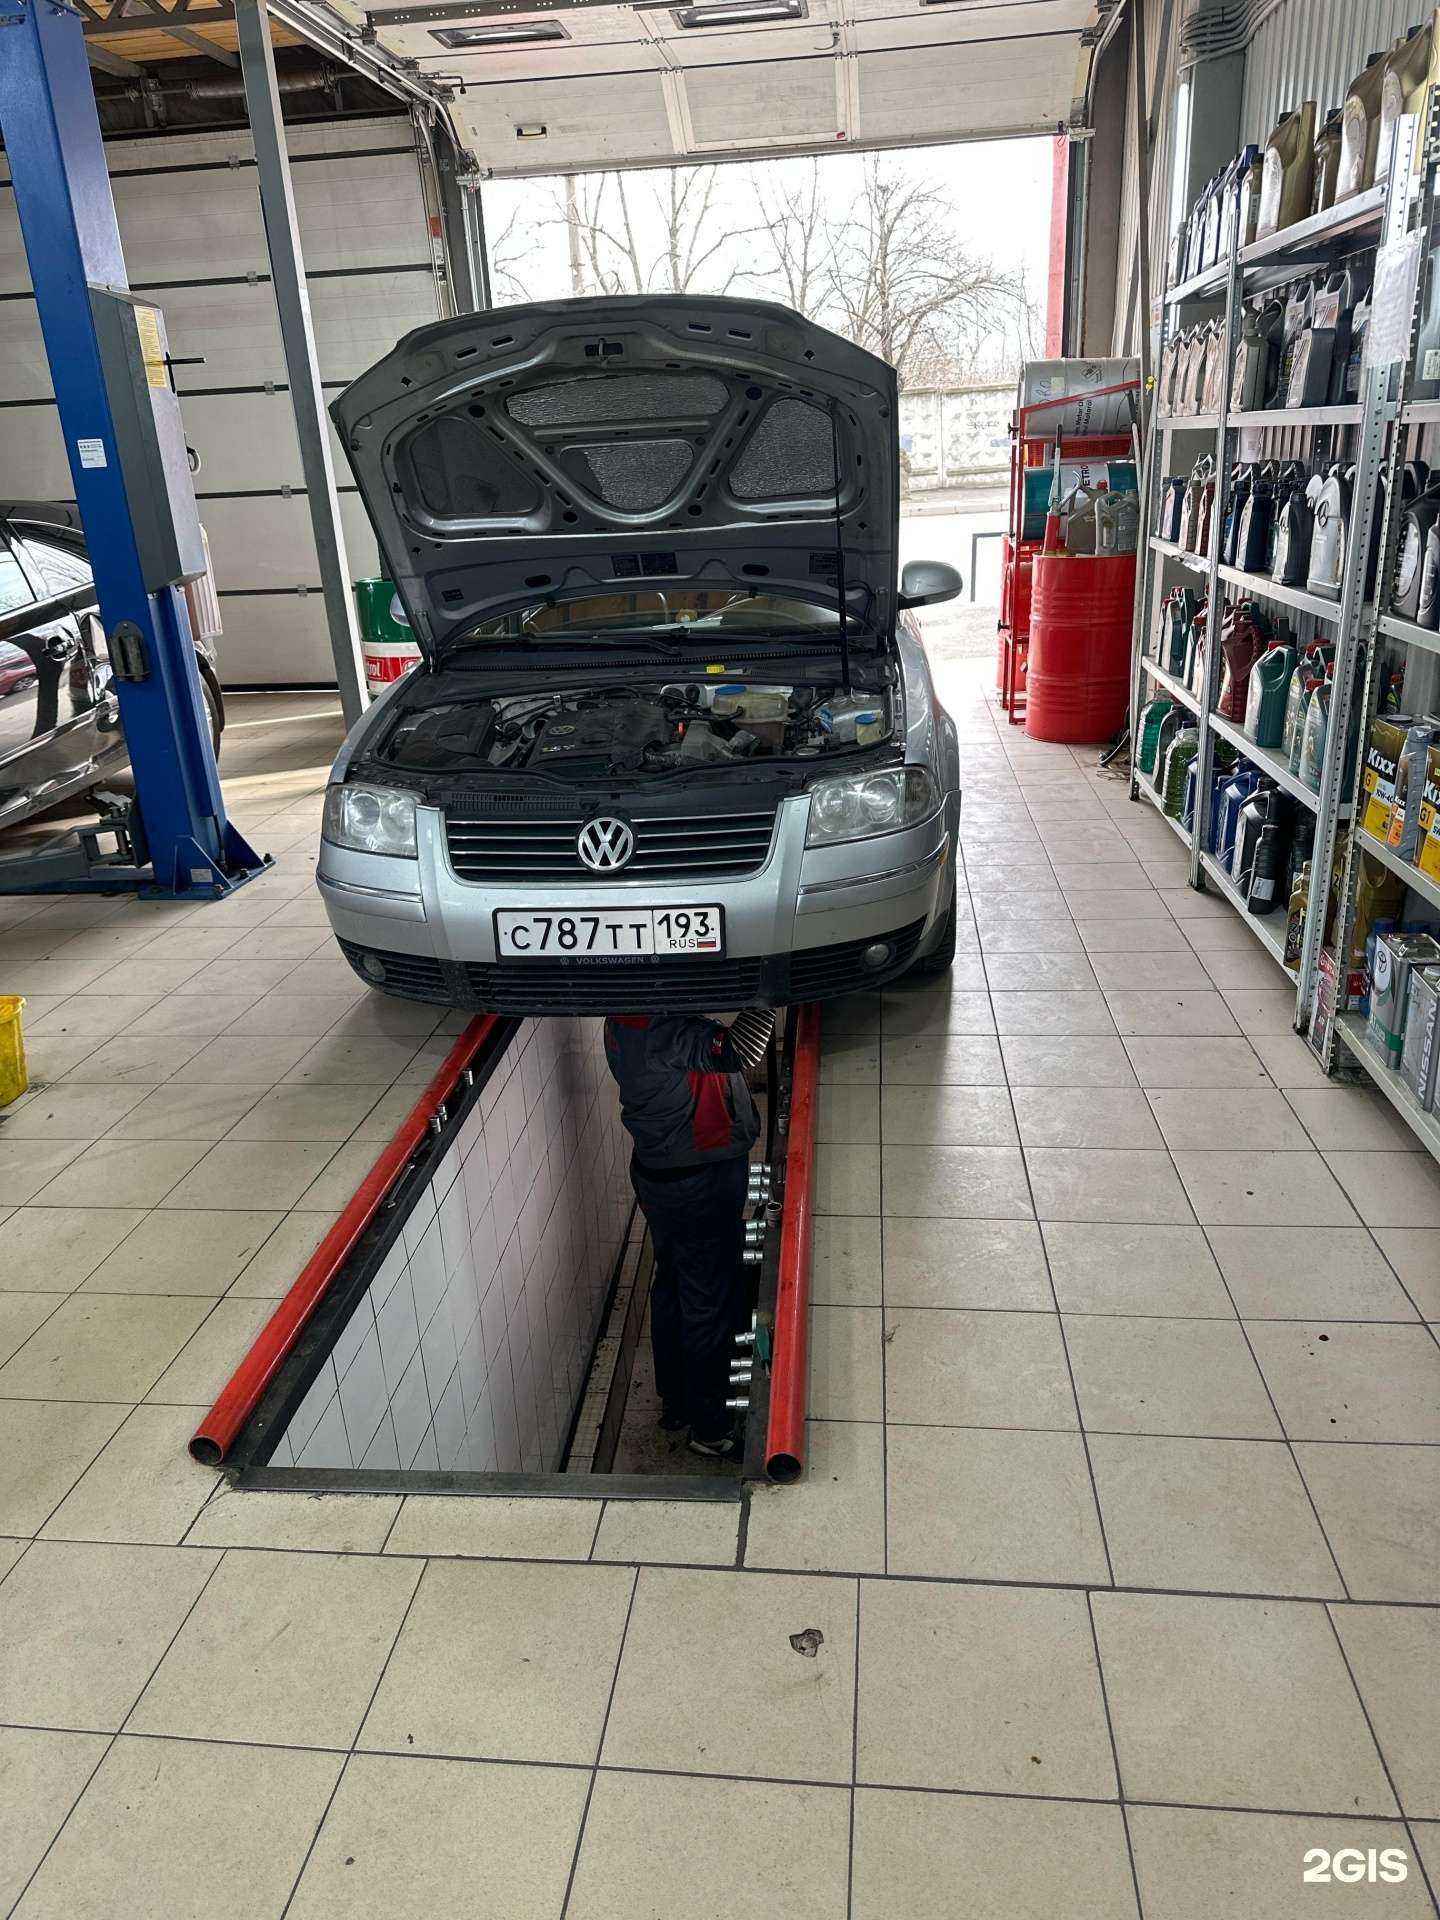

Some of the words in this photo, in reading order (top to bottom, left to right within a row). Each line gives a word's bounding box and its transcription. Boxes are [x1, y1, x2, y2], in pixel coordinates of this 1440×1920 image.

[1367, 746, 1396, 776] Kixx
[1424, 779, 1440, 806] Ki
[657, 912, 710, 938] 193
[669, 938, 696, 949] RUS
[576, 956, 646, 966] VOLKSWAGEN
[1417, 999, 1438, 1100] NISSAN
